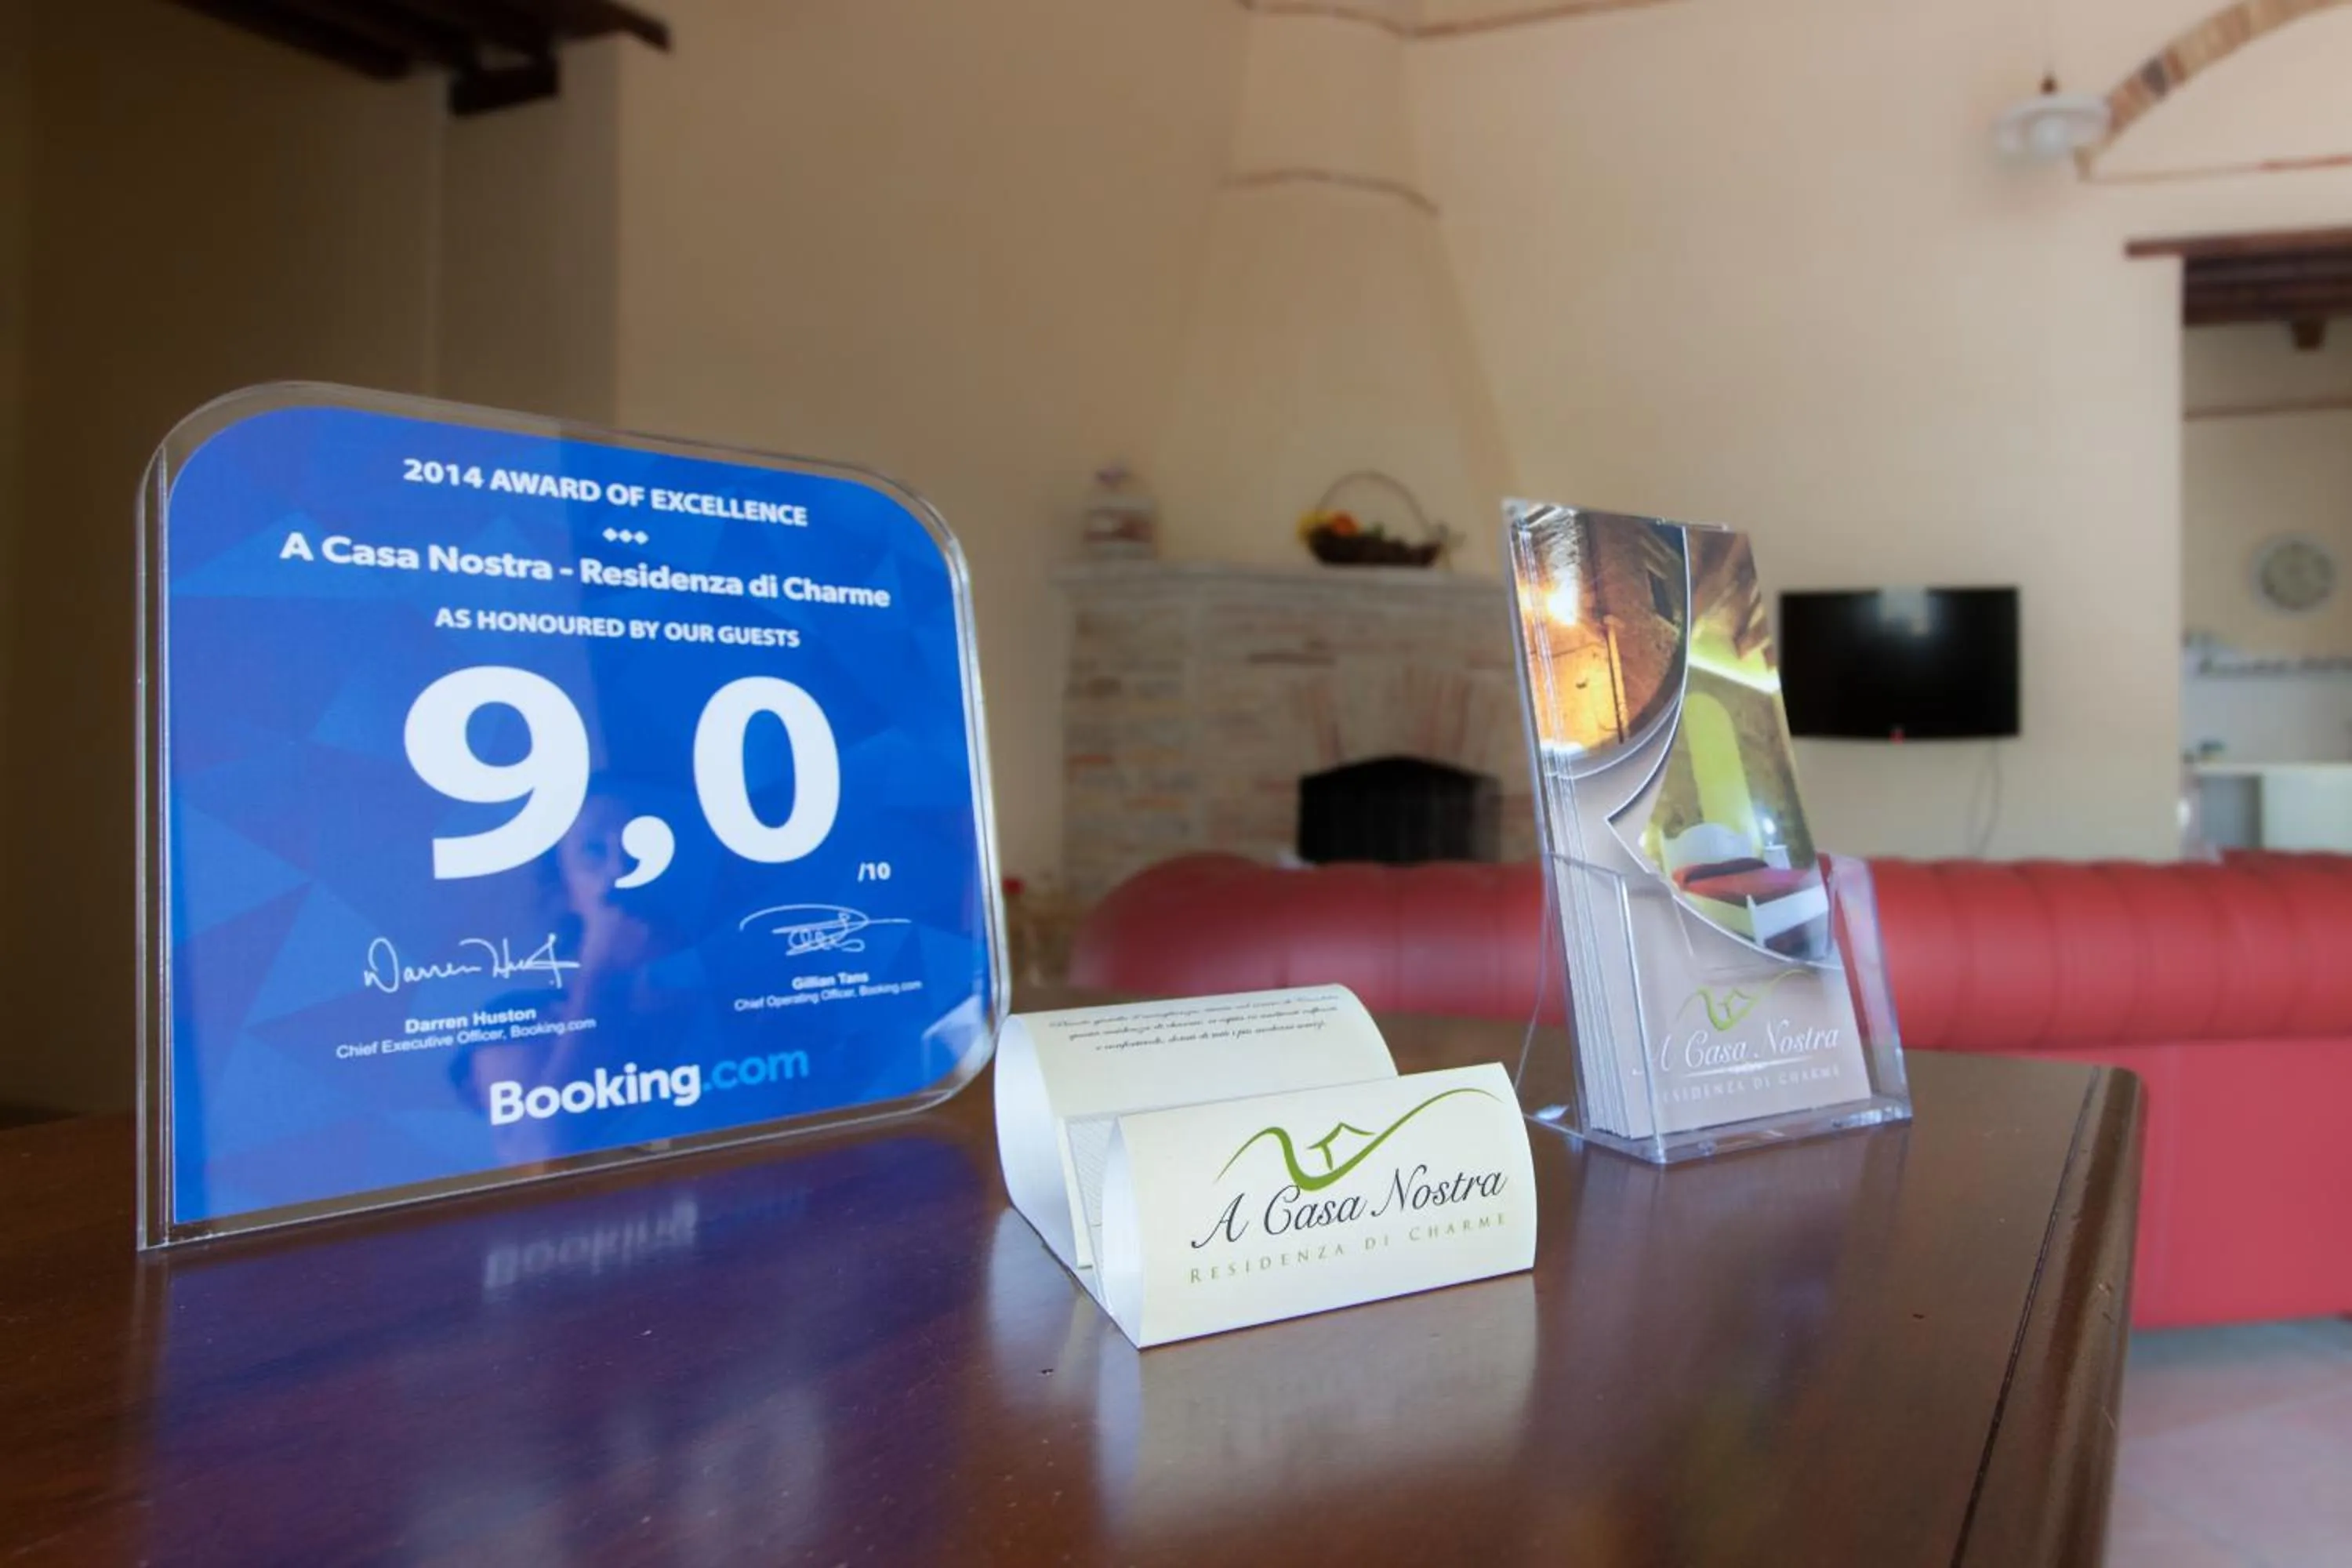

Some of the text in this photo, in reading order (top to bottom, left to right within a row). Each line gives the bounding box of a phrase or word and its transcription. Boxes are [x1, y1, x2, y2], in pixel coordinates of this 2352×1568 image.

[403, 457, 808, 527] 2014 AWARD OF EXCELLENCE
[279, 532, 314, 561] A
[321, 535, 419, 570] Casa
[428, 544, 554, 581] Nostra
[580, 557, 744, 597] Residenza
[749, 574, 779, 599] di
[783, 577, 891, 608] Charme
[434, 607, 800, 648] AS HONOURED BY OUR GUESTS
[404, 666, 840, 888] 9,0
[857, 862, 891, 882] /10
[336, 1042, 377, 1059] Chief
[381, 1033, 455, 1054] Executive
[510, 1018, 597, 1036] Booking.com
[405, 1008, 537, 1034] Darren Huston
[1685, 1029, 1748, 1069] Casa
[489, 1049, 811, 1126] Booking.com
[1190, 1163, 1510, 1250] A Casa Nostra
[1189, 1213, 1506, 1284] RESIDENZA DI CHARME
